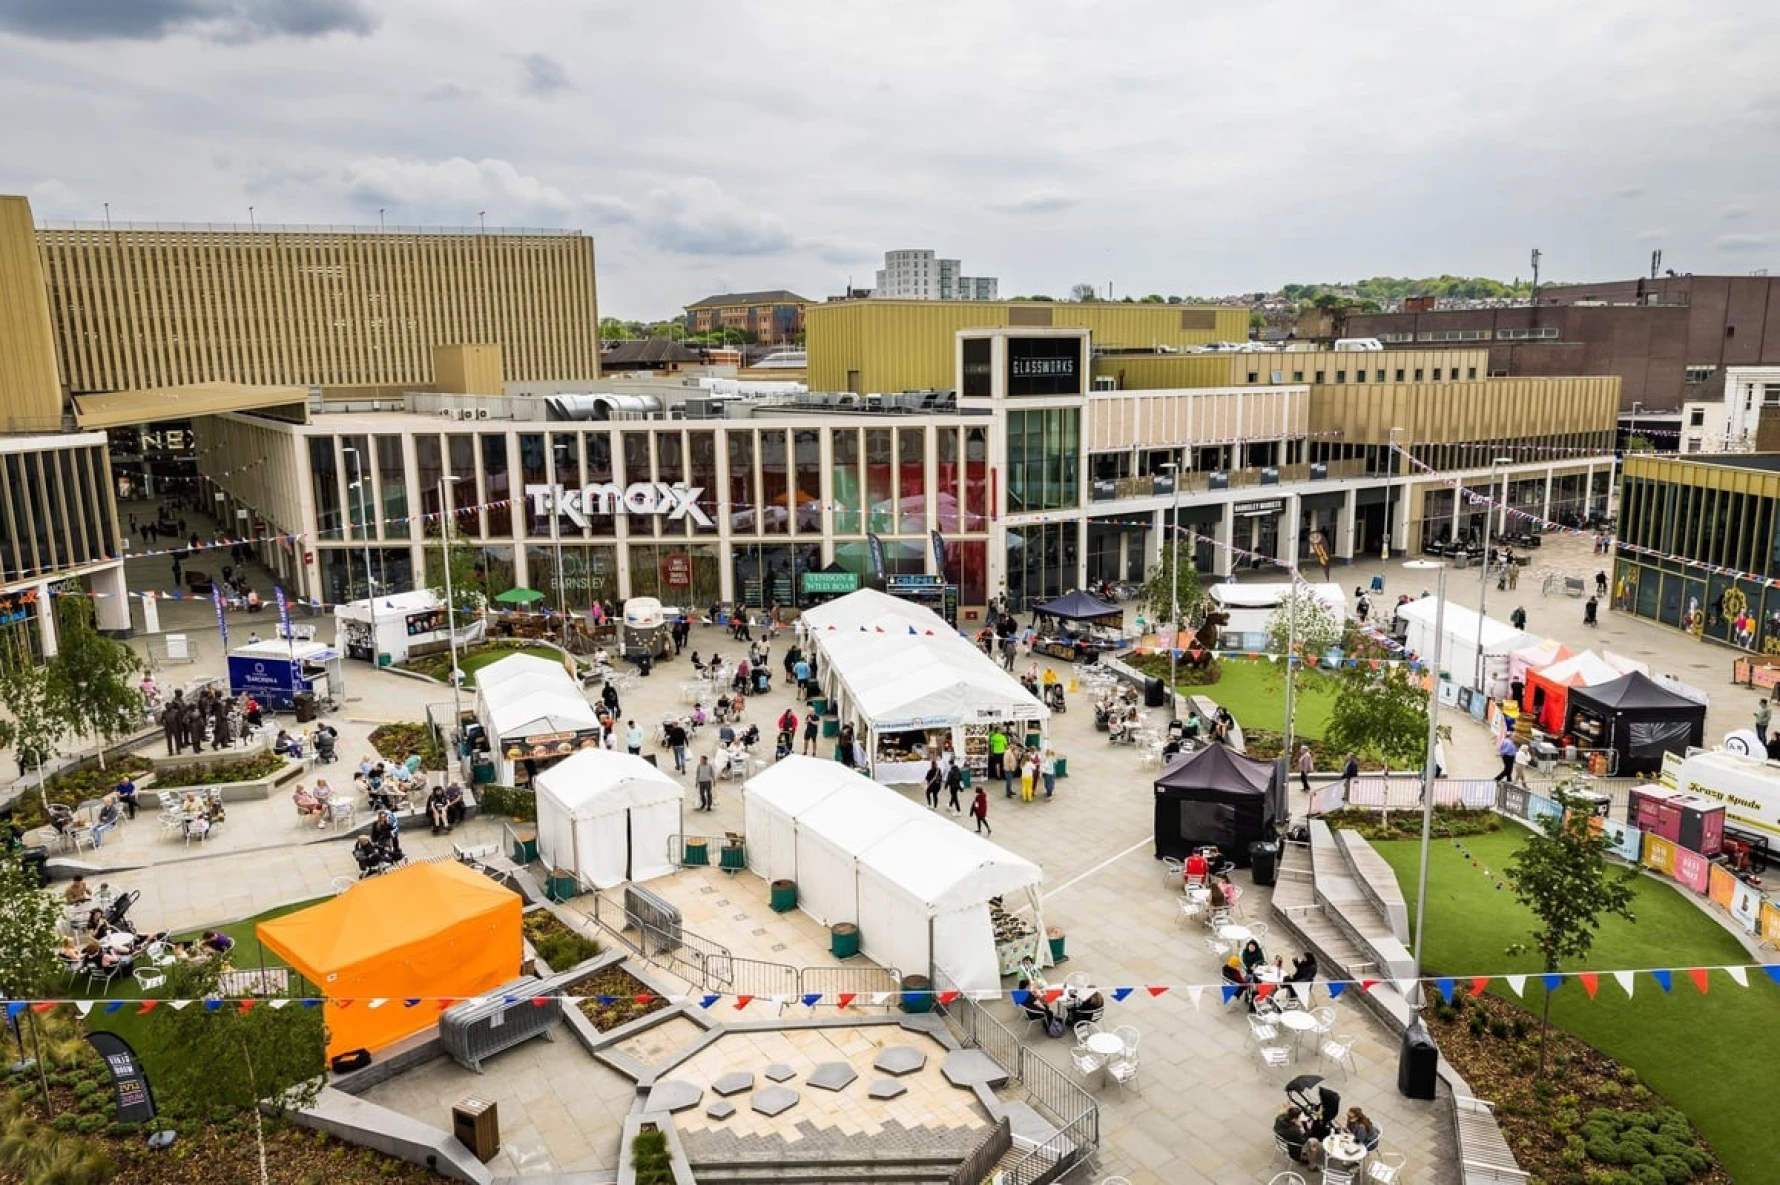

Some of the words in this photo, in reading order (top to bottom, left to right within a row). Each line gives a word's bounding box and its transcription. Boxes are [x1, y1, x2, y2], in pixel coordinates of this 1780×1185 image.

[1013, 360, 1073, 374] GLASSWORKS
[1689, 782, 1724, 802] Krazy
[1727, 794, 1761, 811] Spuds
